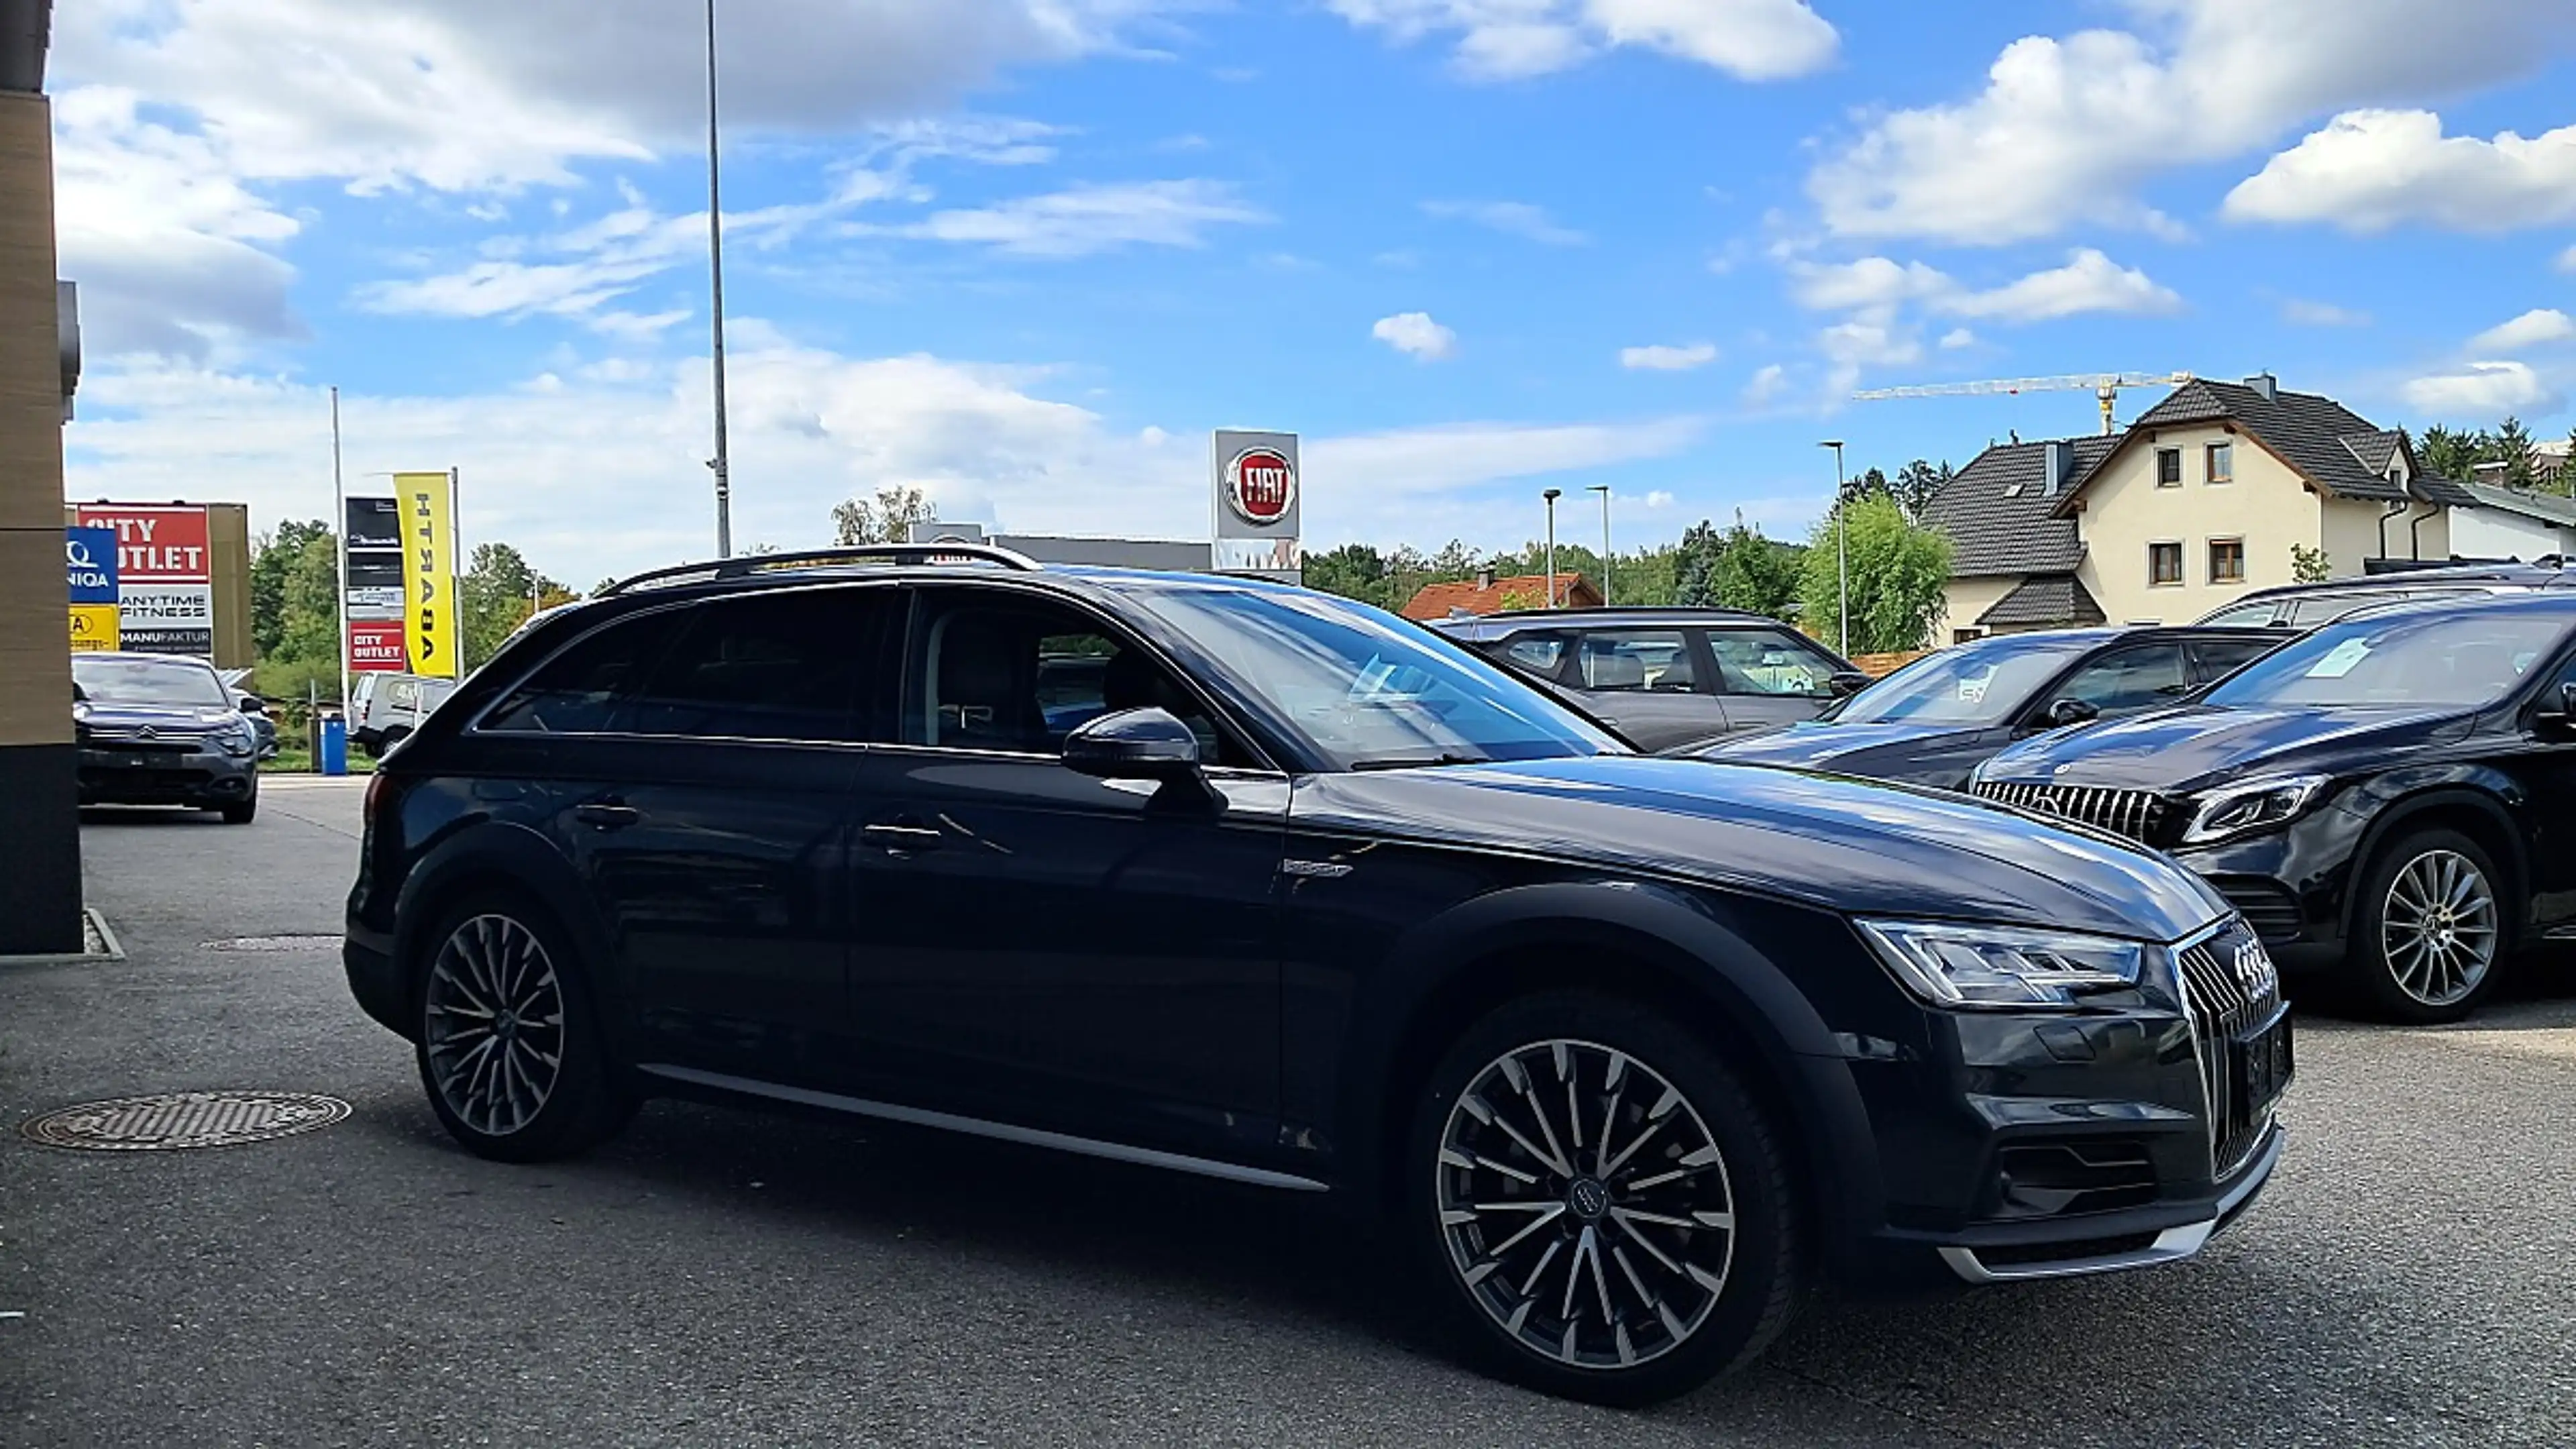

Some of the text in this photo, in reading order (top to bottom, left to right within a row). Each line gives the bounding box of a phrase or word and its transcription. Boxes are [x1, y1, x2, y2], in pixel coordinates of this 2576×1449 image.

[1245, 468, 1285, 503] FIAT
[66, 572, 109, 586] NIQA
[121, 596, 205, 606] ANYTIME
[120, 607, 205, 617] FITNESS
[120, 632, 209, 643] MANUFAKTUR
[354, 635, 383, 645] CITY
[354, 646, 400, 657] OUTLET
